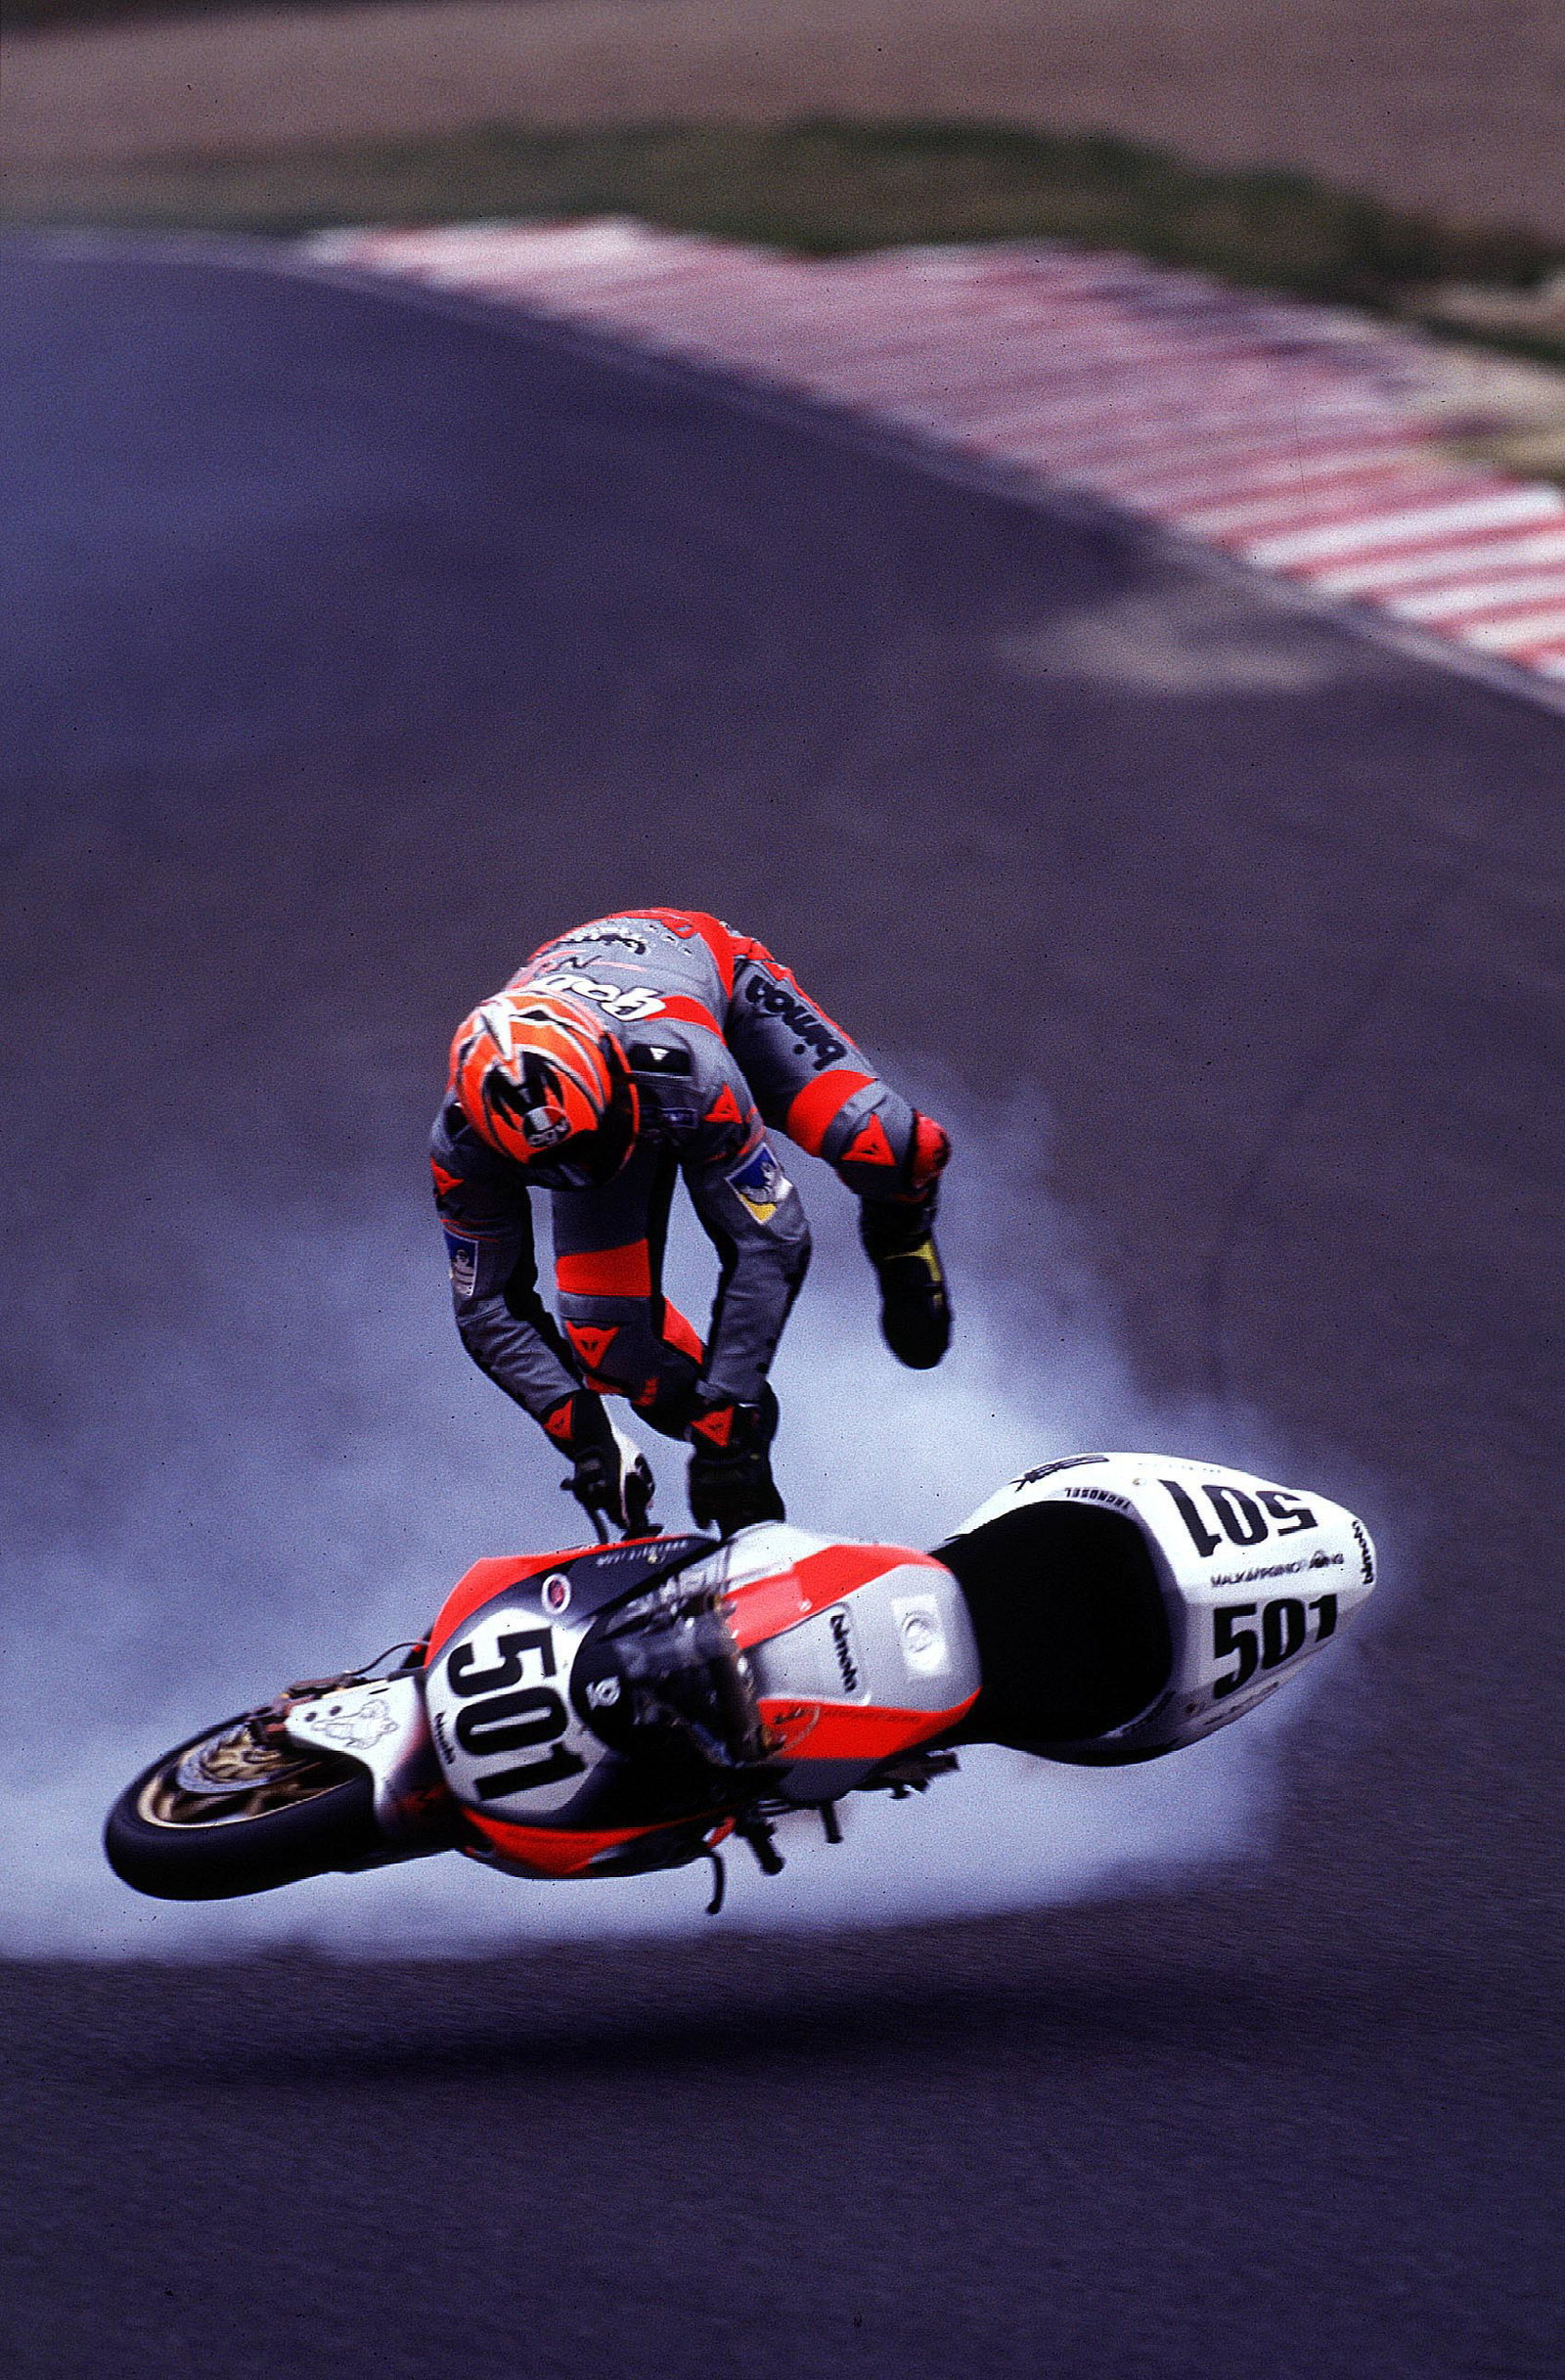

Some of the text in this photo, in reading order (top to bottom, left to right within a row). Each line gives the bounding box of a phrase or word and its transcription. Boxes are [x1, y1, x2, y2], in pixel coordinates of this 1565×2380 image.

[1158, 1479, 1318, 1557] 501
[1213, 1594, 1337, 1699] 501
[446, 1627, 586, 1801] 501
